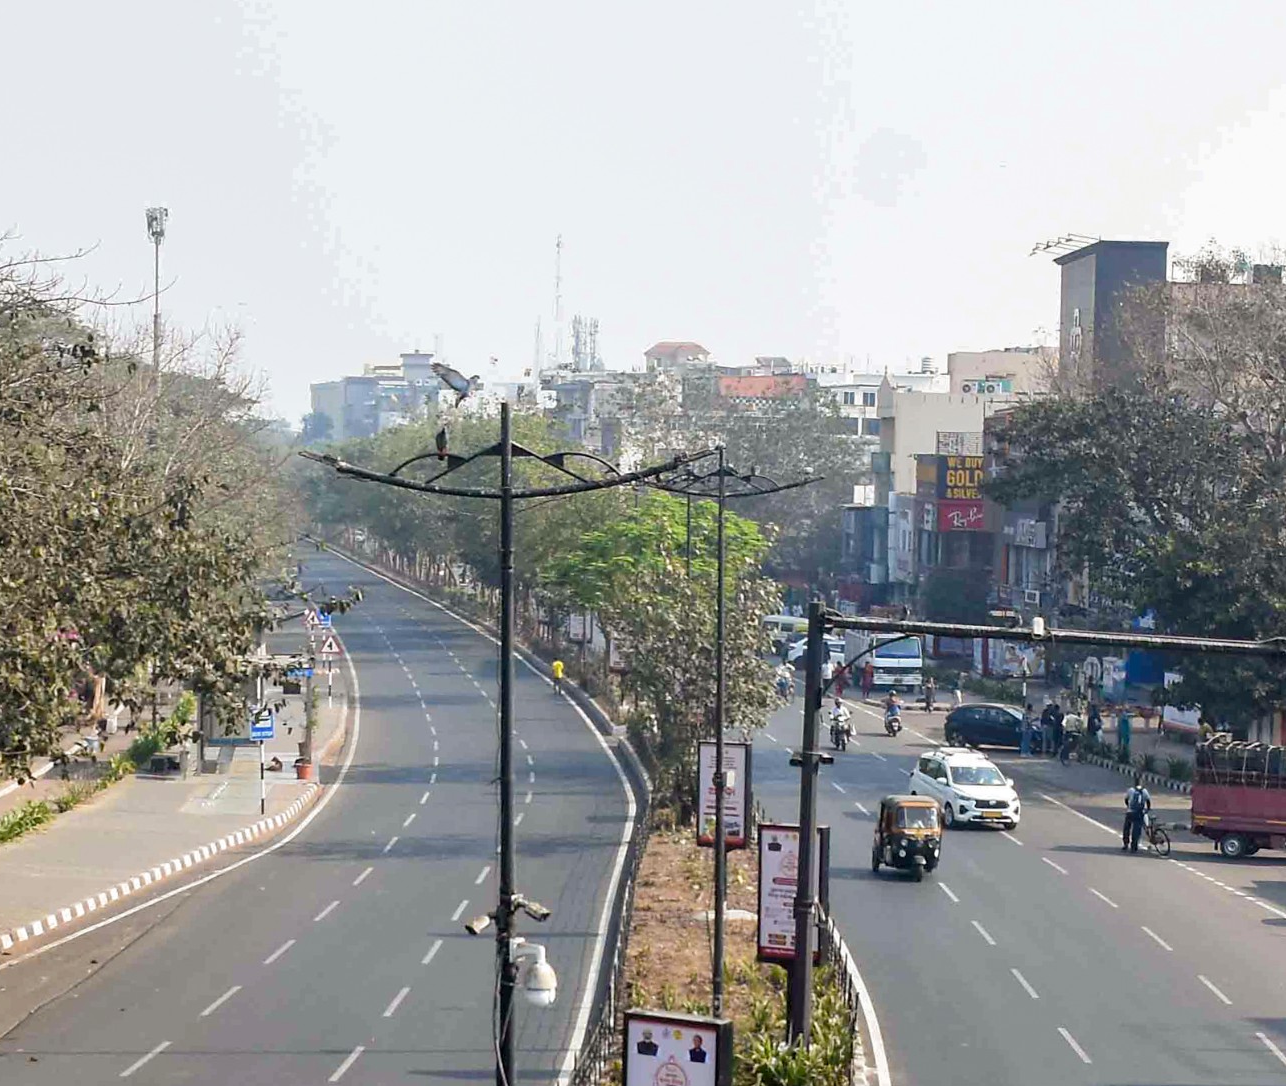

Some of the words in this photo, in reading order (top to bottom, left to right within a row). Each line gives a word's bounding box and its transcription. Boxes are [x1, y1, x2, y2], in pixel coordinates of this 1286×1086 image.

[947, 457, 963, 468] WE
[965, 457, 984, 468] BUY
[946, 470, 984, 487] GOLD
